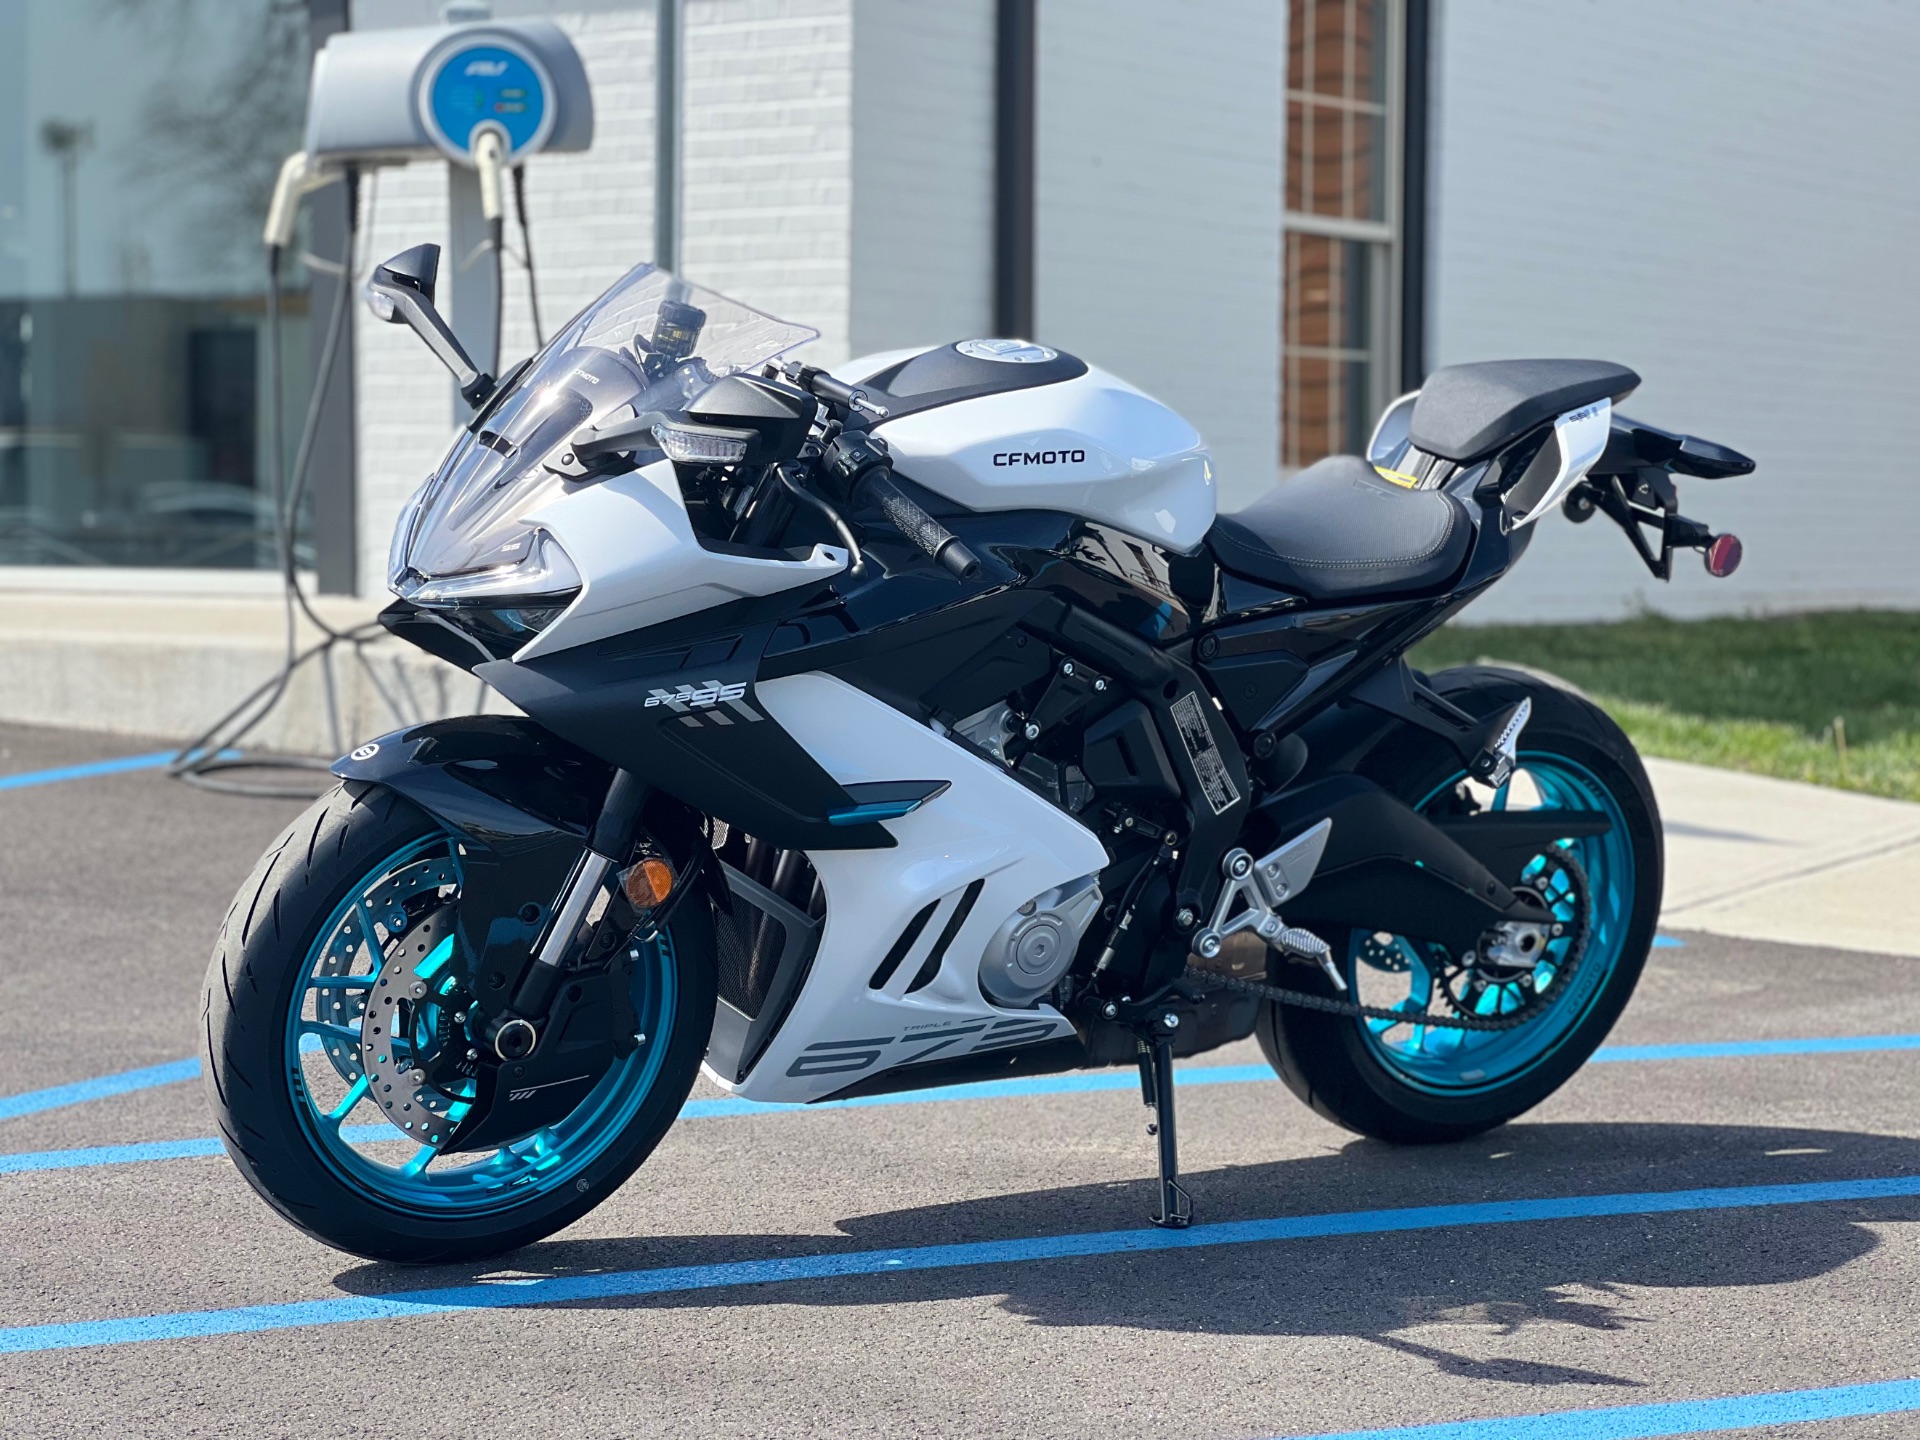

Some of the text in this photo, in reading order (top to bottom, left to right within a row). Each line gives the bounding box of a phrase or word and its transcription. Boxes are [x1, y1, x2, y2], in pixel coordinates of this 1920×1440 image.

[1569, 412, 1587, 422] SS
[993, 449, 1085, 467] CFMOTO
[501, 542, 521, 552] SS
[903, 1020, 952, 1031] TRIPLE
[785, 1018, 1058, 1078] 675
